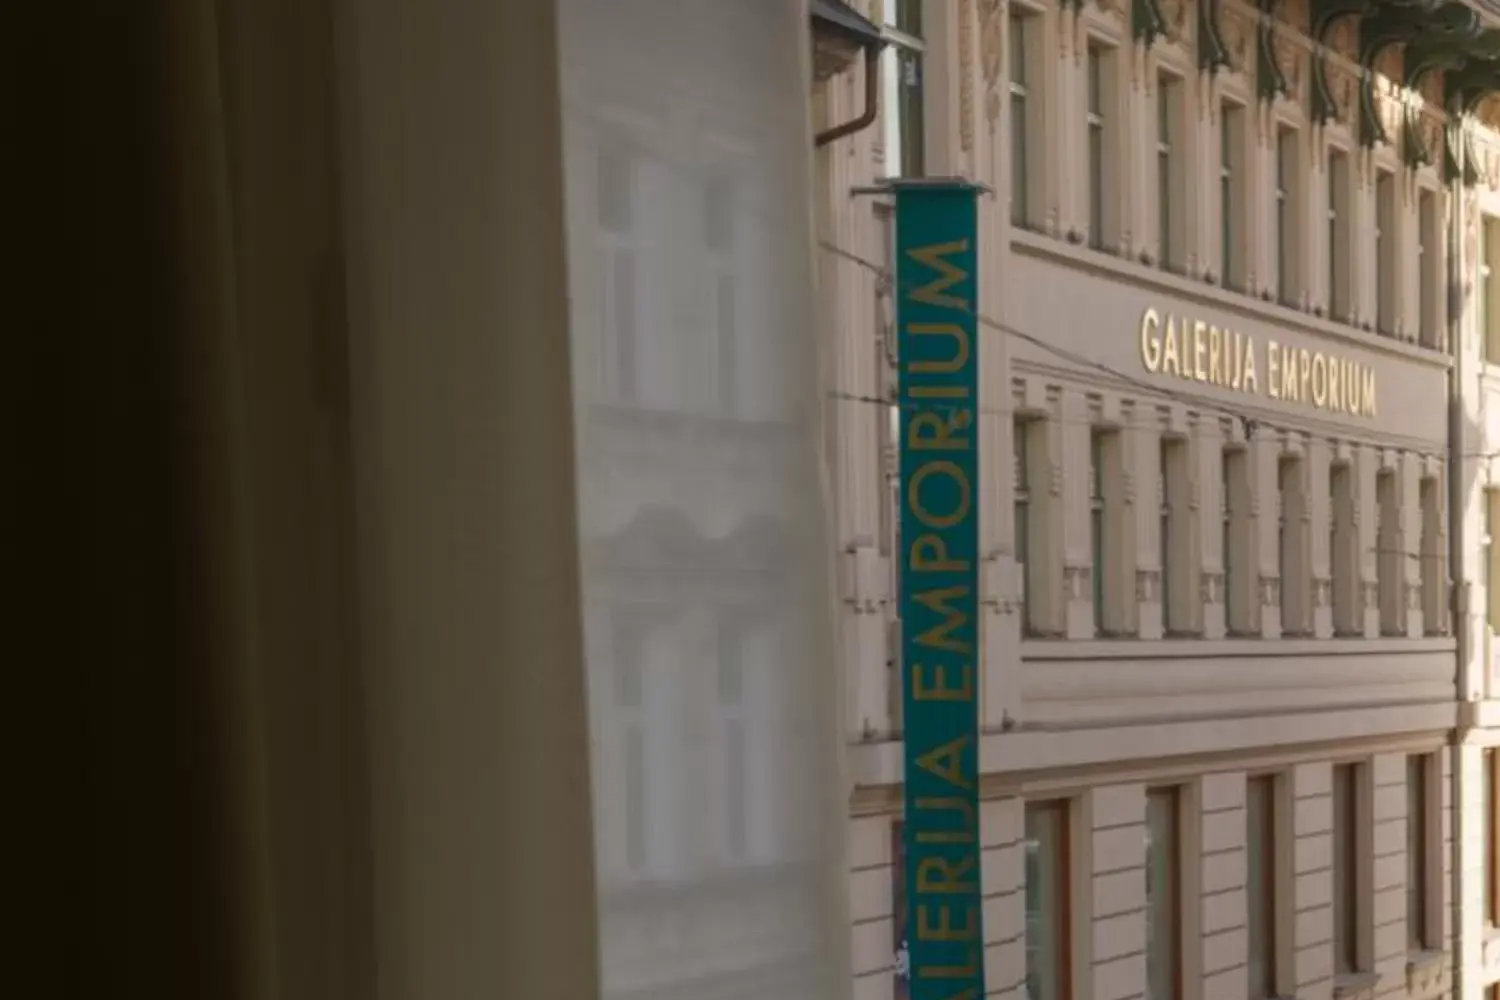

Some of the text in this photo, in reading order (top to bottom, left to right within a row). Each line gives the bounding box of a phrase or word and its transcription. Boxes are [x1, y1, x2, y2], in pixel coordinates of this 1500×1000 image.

[906, 236, 972, 702] EMPORIUM
[1141, 307, 1377, 418] GALERIJA EMPORIUM
